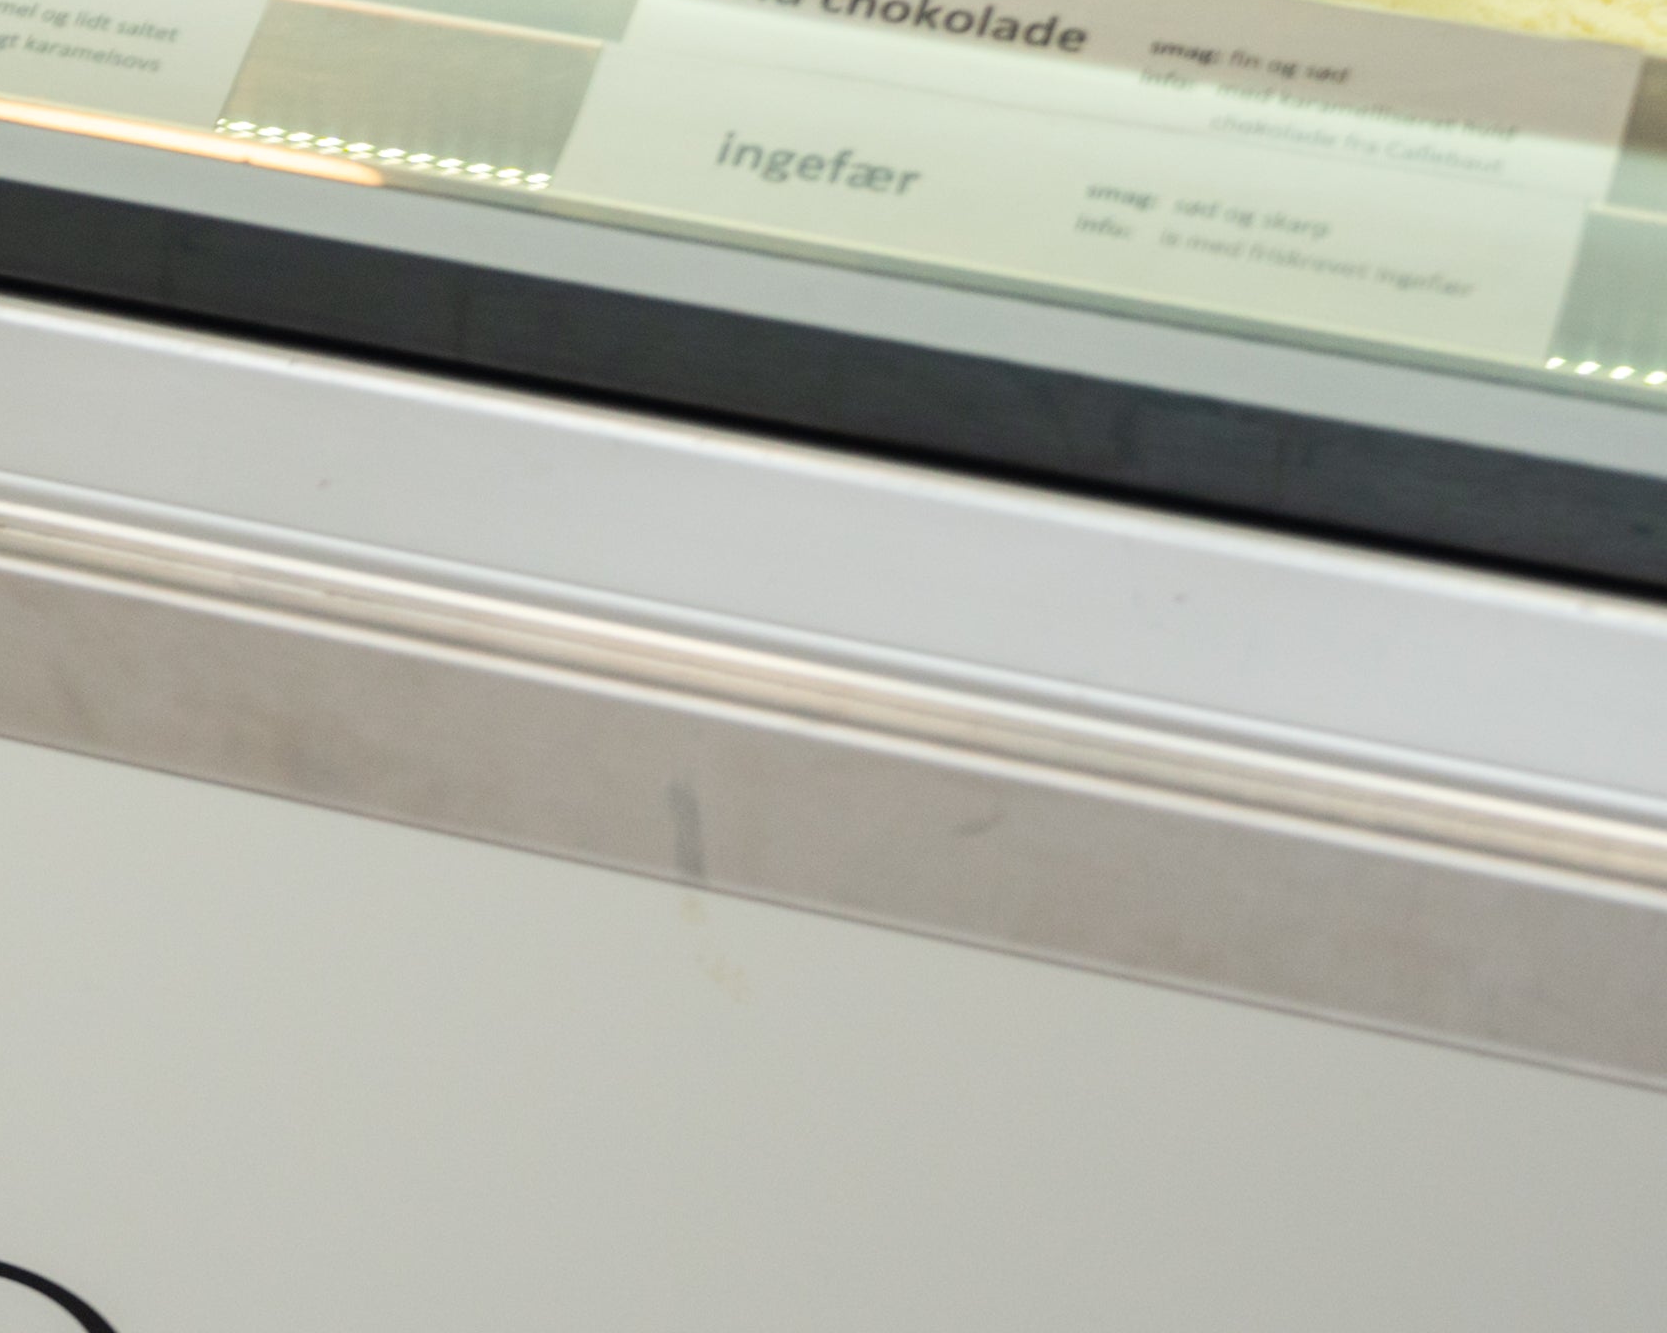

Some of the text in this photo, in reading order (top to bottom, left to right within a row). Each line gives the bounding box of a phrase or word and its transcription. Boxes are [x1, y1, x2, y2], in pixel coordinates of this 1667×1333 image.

[40, 5, 69, 30] og
[75, 9, 113, 33] lidt
[116, 18, 181, 45] saltet
[23, 33, 164, 75] karamelsovs
[1267, 57, 1299, 82] og
[716, 130, 921, 198] ingefær
